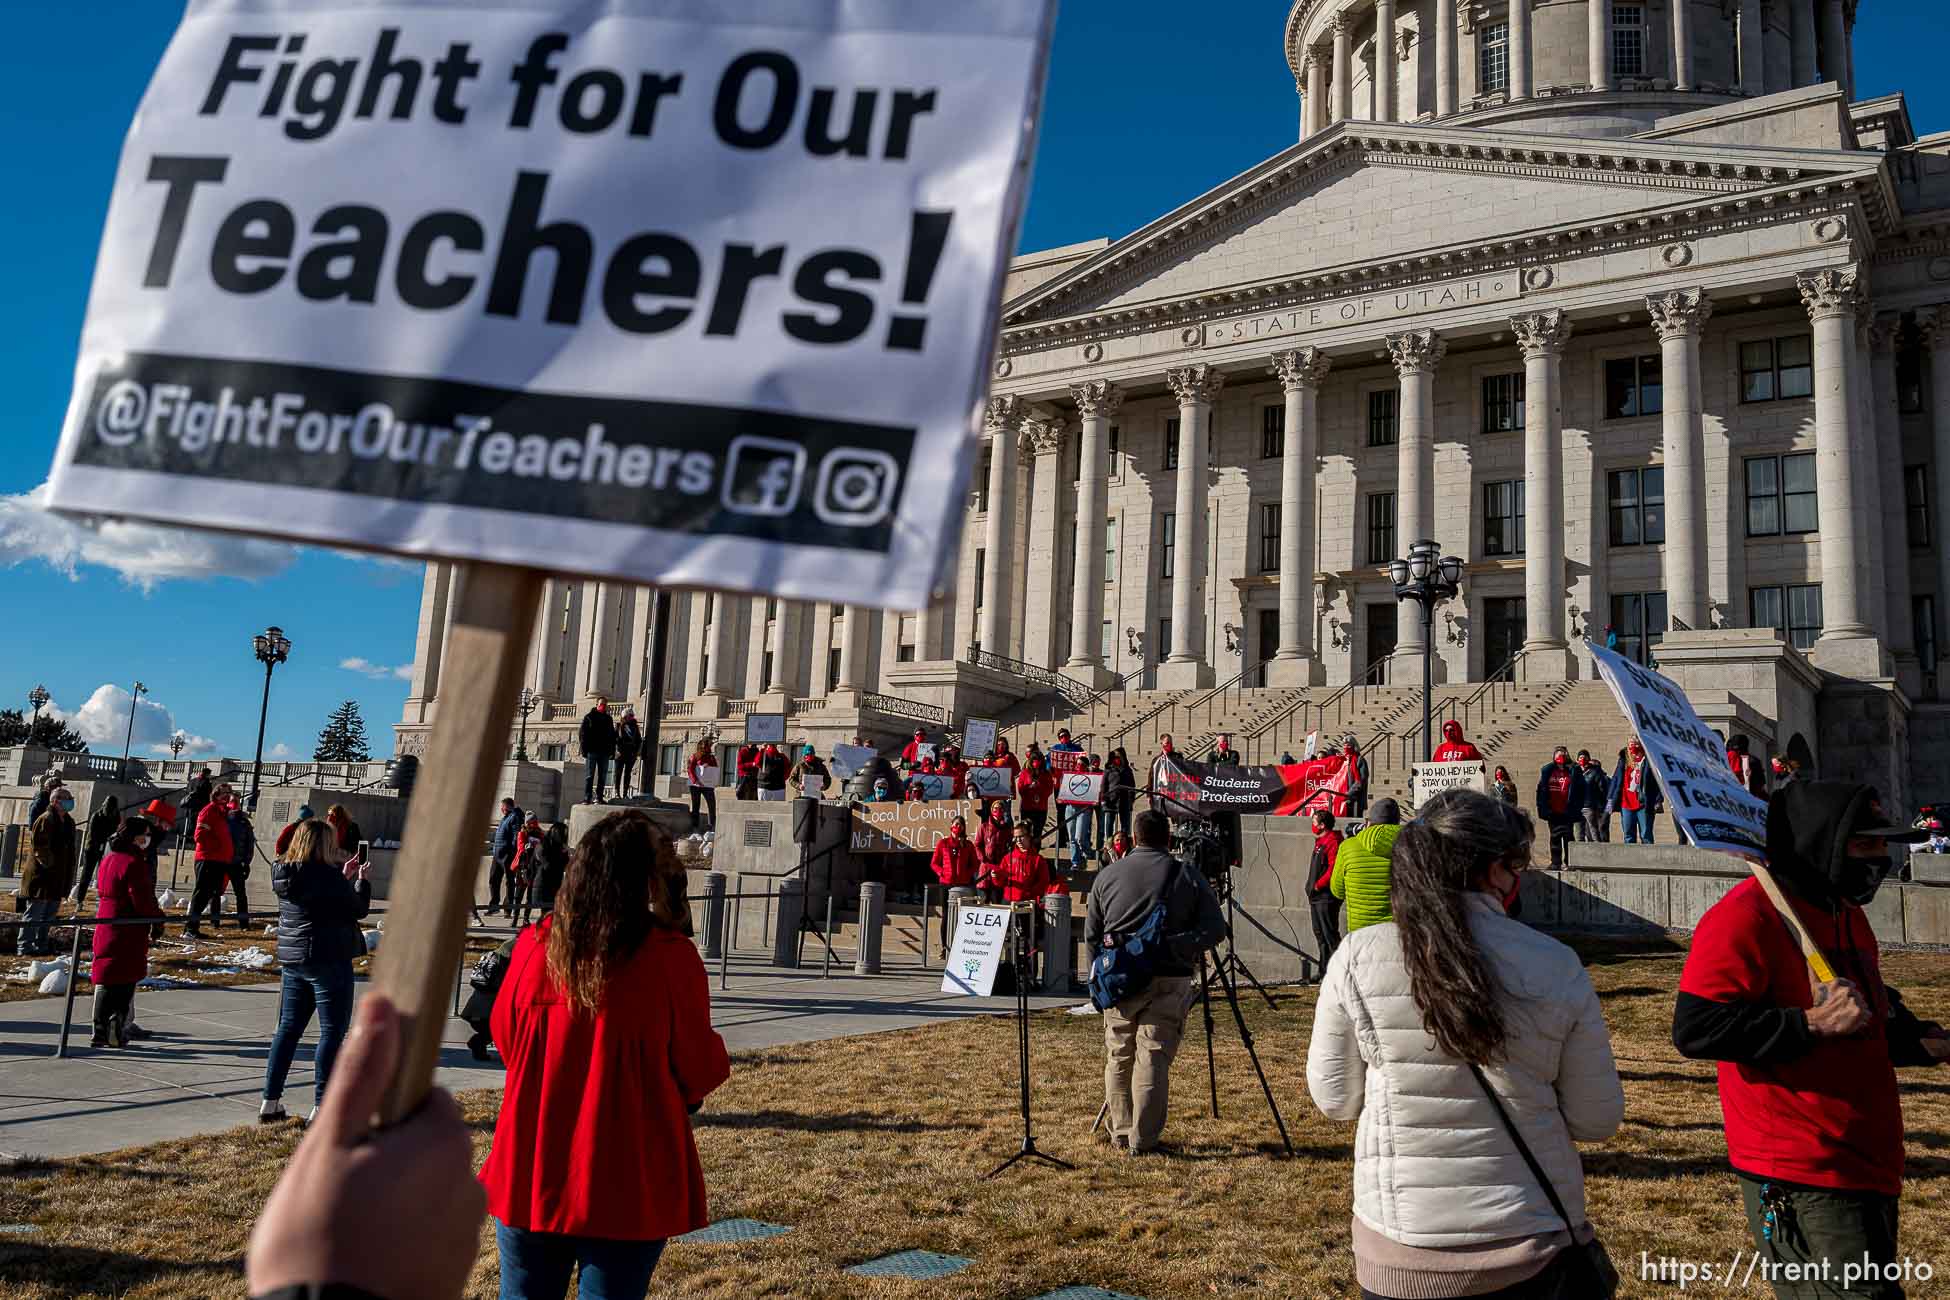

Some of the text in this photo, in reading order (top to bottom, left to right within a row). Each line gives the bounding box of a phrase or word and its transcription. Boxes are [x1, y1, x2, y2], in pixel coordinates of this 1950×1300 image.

[200, 28, 935, 162] Fight for Our
[143, 155, 952, 352] Teachers!
[1231, 281, 1481, 338] STATE OF UTAH
[97, 383, 712, 495] @FightForOurTeachers
[1443, 751, 1463, 759] EAST
[1422, 768, 1433, 777] HO
[1448, 767, 1461, 776] HEY
[1464, 766, 1478, 775] HEY
[1204, 776, 1261, 789] Students
[1307, 779, 1333, 787] SLEA
[1422, 778, 1471, 787] STAY OUT OF
[1201, 790, 1269, 804] Profession
[861, 799, 972, 825] Local Control?
[851, 831, 875, 849] Not
[882, 829, 892, 850] 4
[897, 826, 927, 850] SLC
[965, 912, 1002, 928] SLEA
